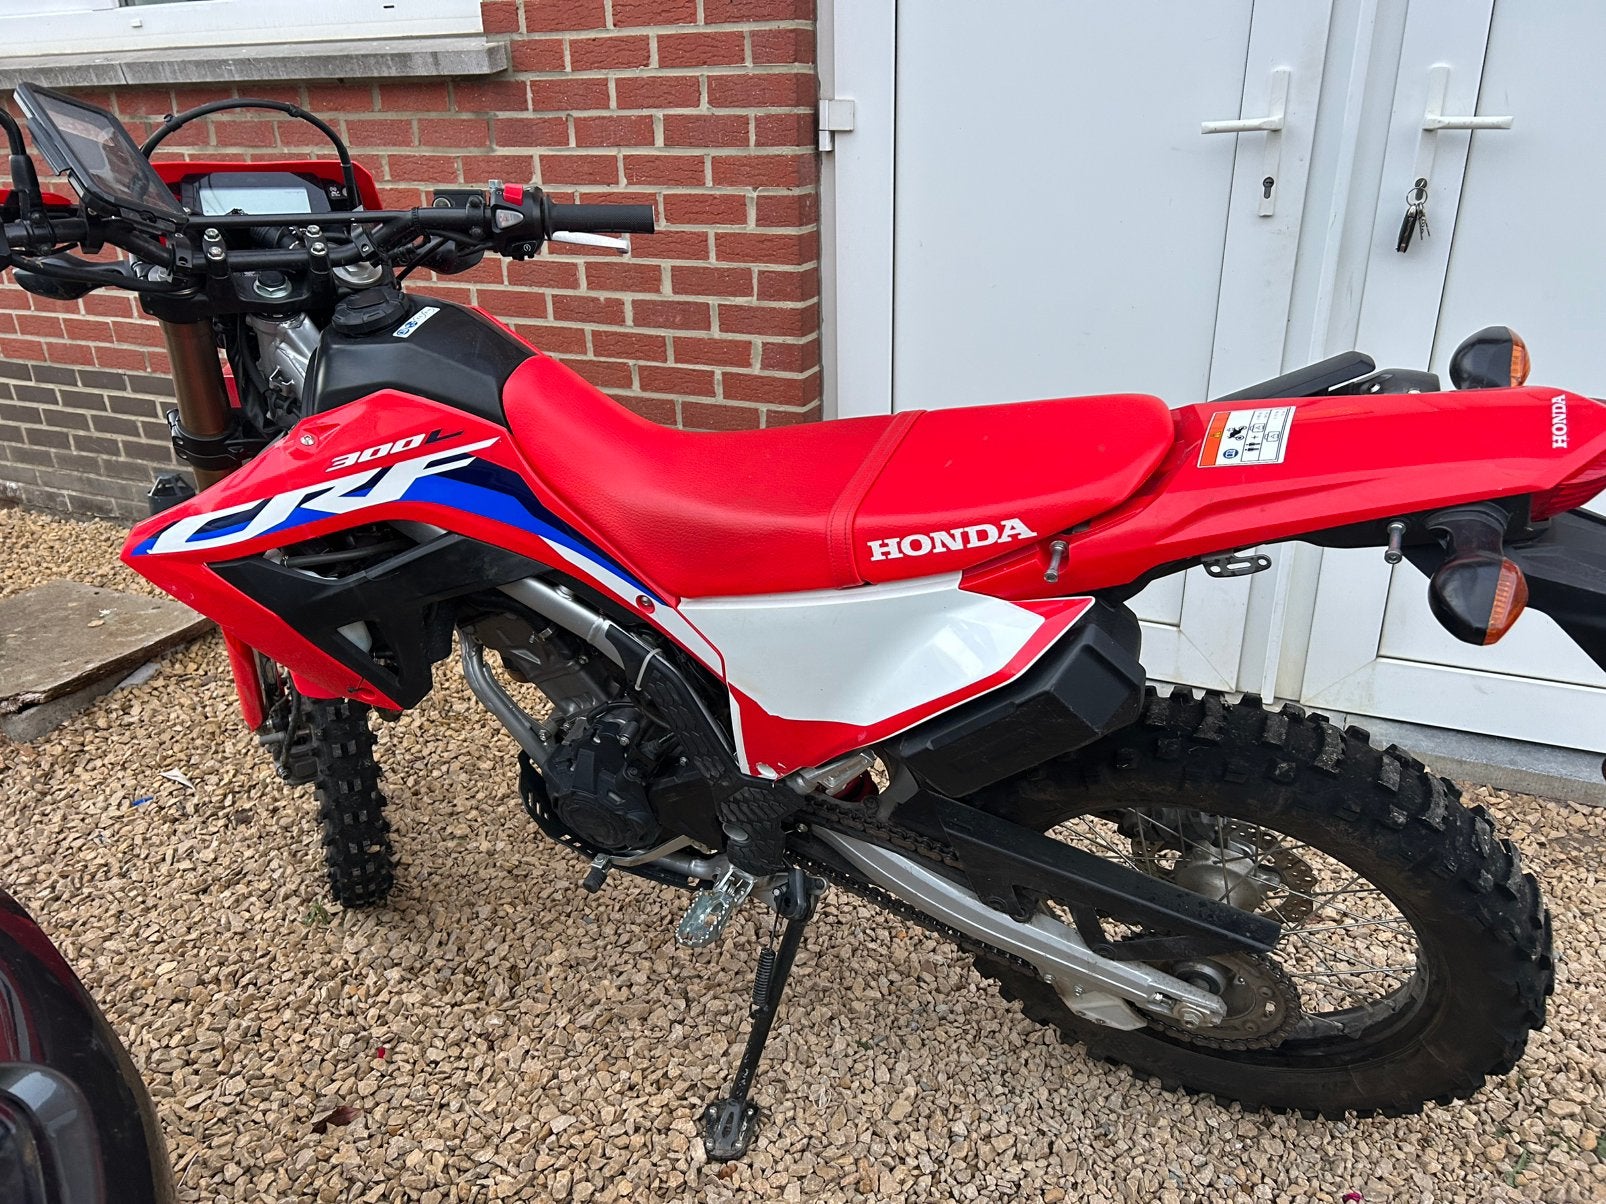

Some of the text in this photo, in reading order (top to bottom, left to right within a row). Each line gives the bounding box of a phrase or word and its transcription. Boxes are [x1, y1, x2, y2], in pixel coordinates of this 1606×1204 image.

[1551, 394, 1568, 449] HONDA
[325, 429, 464, 473] 300L
[146, 436, 502, 555] CRF
[867, 517, 1038, 561] HONDA
